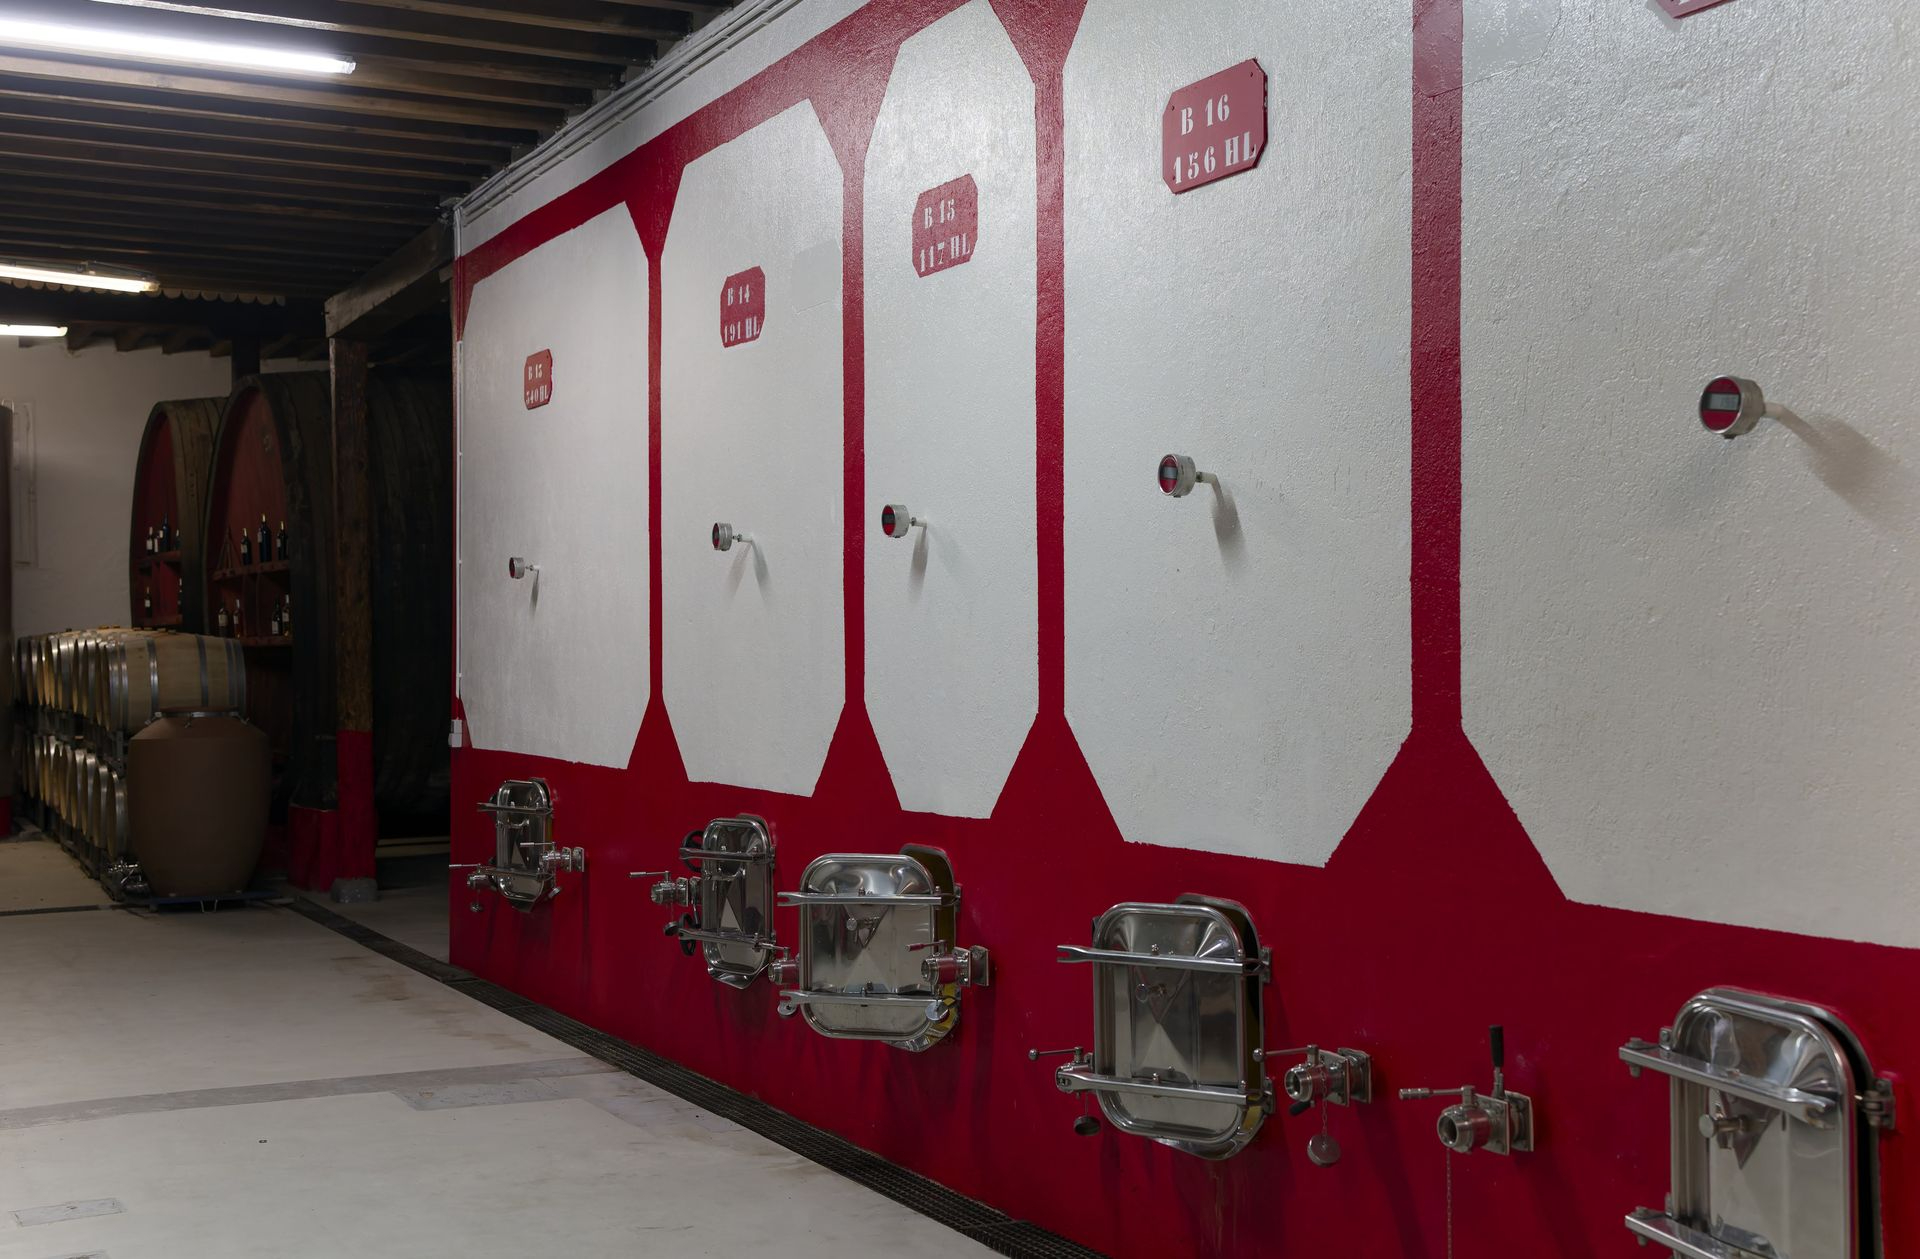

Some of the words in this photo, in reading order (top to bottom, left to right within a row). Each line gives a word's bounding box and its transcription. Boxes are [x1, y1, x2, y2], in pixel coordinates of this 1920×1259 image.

[1181, 107, 1194, 135] B
[1205, 94, 1230, 127] 16
[1173, 146, 1216, 184] 156
[1225, 131, 1257, 167] HL
[924, 206, 932, 229] B
[940, 198, 955, 224] 15
[920, 241, 945, 272] 117
[950, 232, 970, 259] HL
[727, 287, 734, 306] B
[739, 284, 750, 304] 14
[724, 321, 740, 343] 191
[745, 316, 760, 338] HL
[528, 366, 533, 380] B
